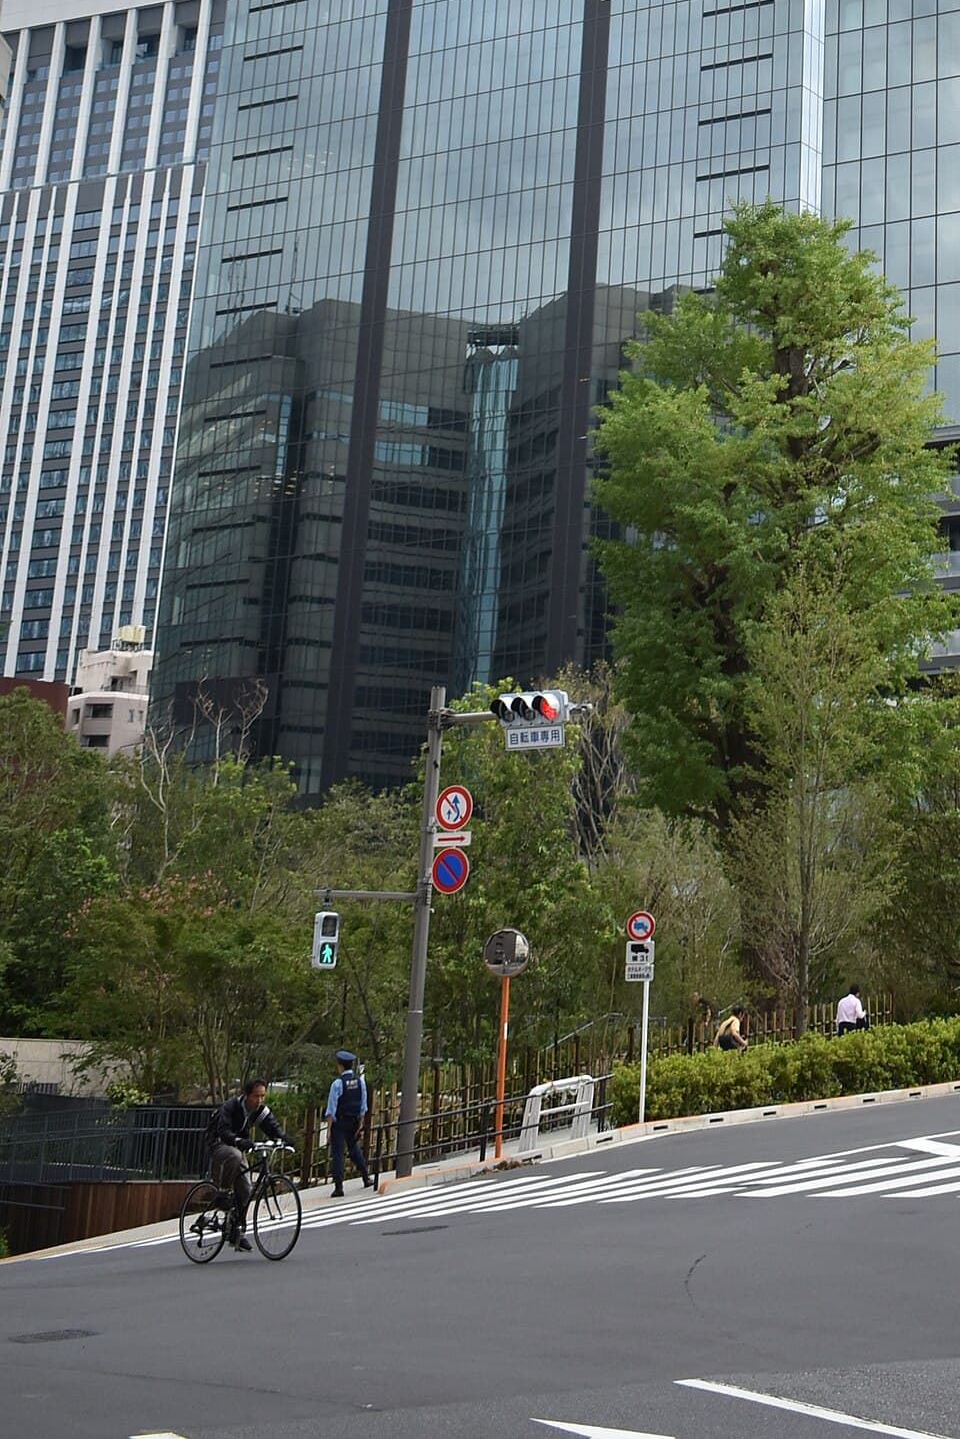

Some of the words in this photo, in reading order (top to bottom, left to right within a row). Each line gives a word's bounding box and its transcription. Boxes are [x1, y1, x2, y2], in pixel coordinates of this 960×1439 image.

[510, 729, 560, 745] 自転車専用
